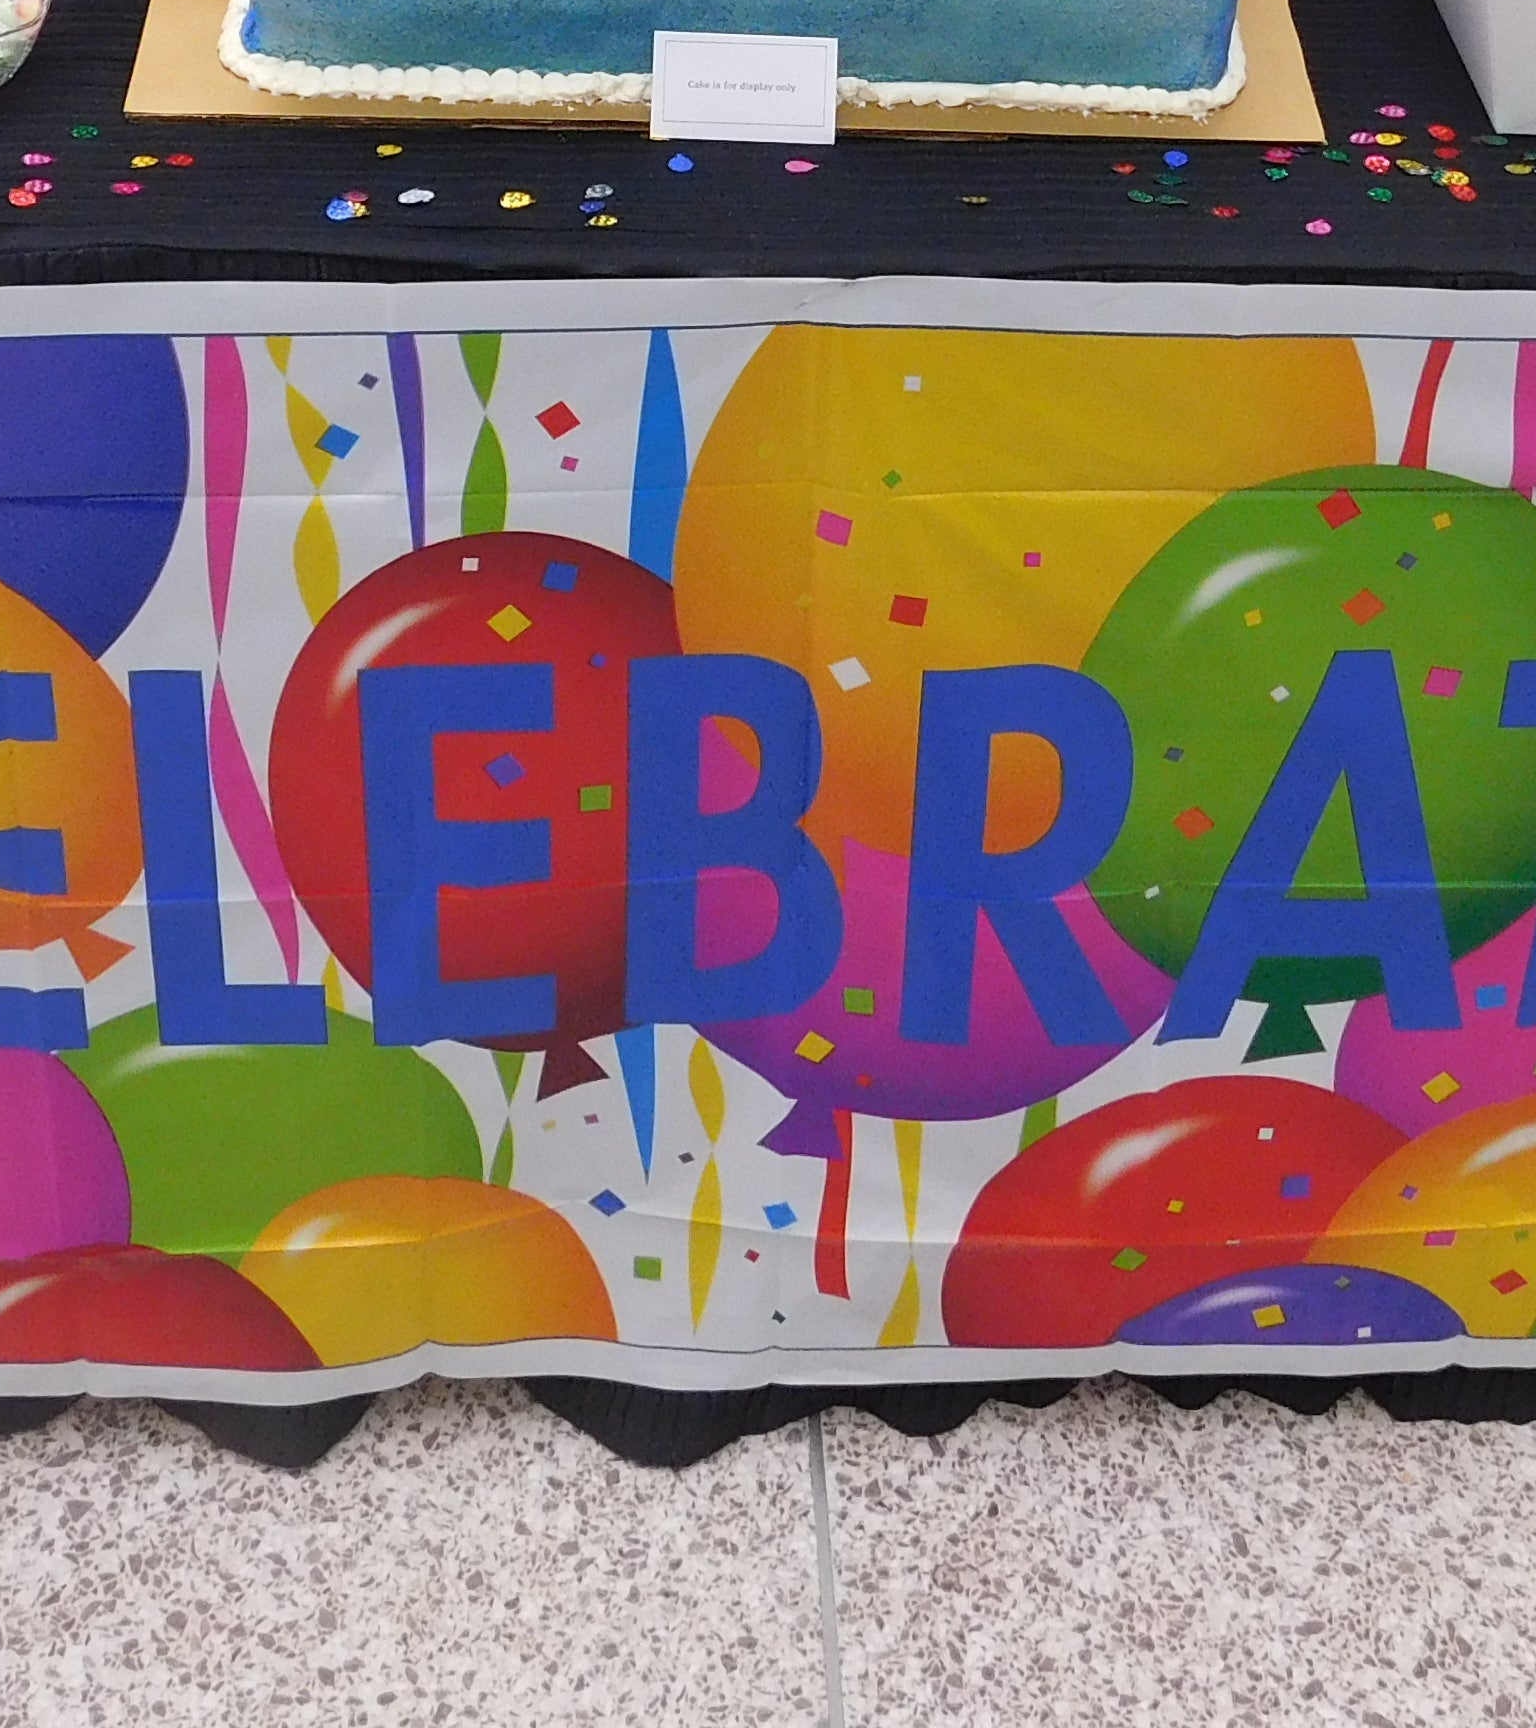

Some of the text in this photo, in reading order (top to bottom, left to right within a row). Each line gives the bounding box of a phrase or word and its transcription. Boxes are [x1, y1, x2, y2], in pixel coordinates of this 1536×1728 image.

[687, 80, 711, 90] Cake
[723, 80, 737, 90] for
[739, 81, 774, 93] display
[775, 83, 798, 95] only
